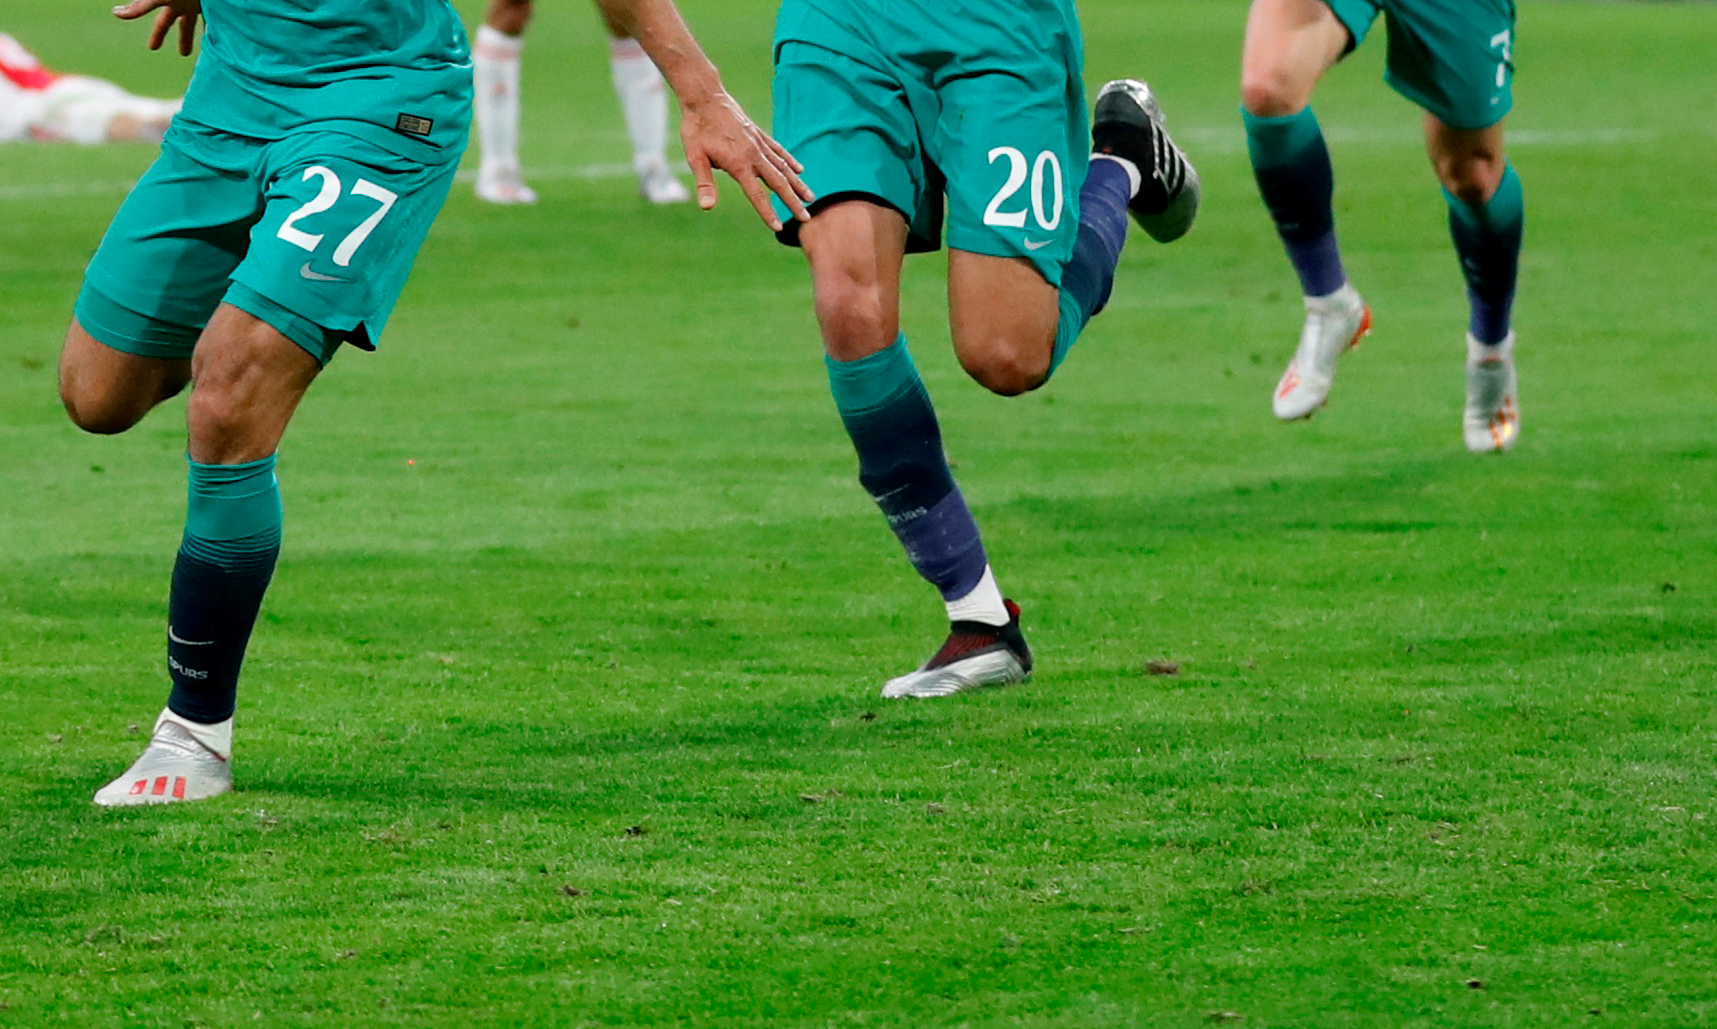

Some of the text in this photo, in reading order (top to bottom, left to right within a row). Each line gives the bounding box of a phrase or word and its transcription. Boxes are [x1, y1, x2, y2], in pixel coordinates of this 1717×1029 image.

[276, 165, 398, 267] 27
[983, 146, 1064, 231] 20
[169, 656, 208, 679] SPURS
